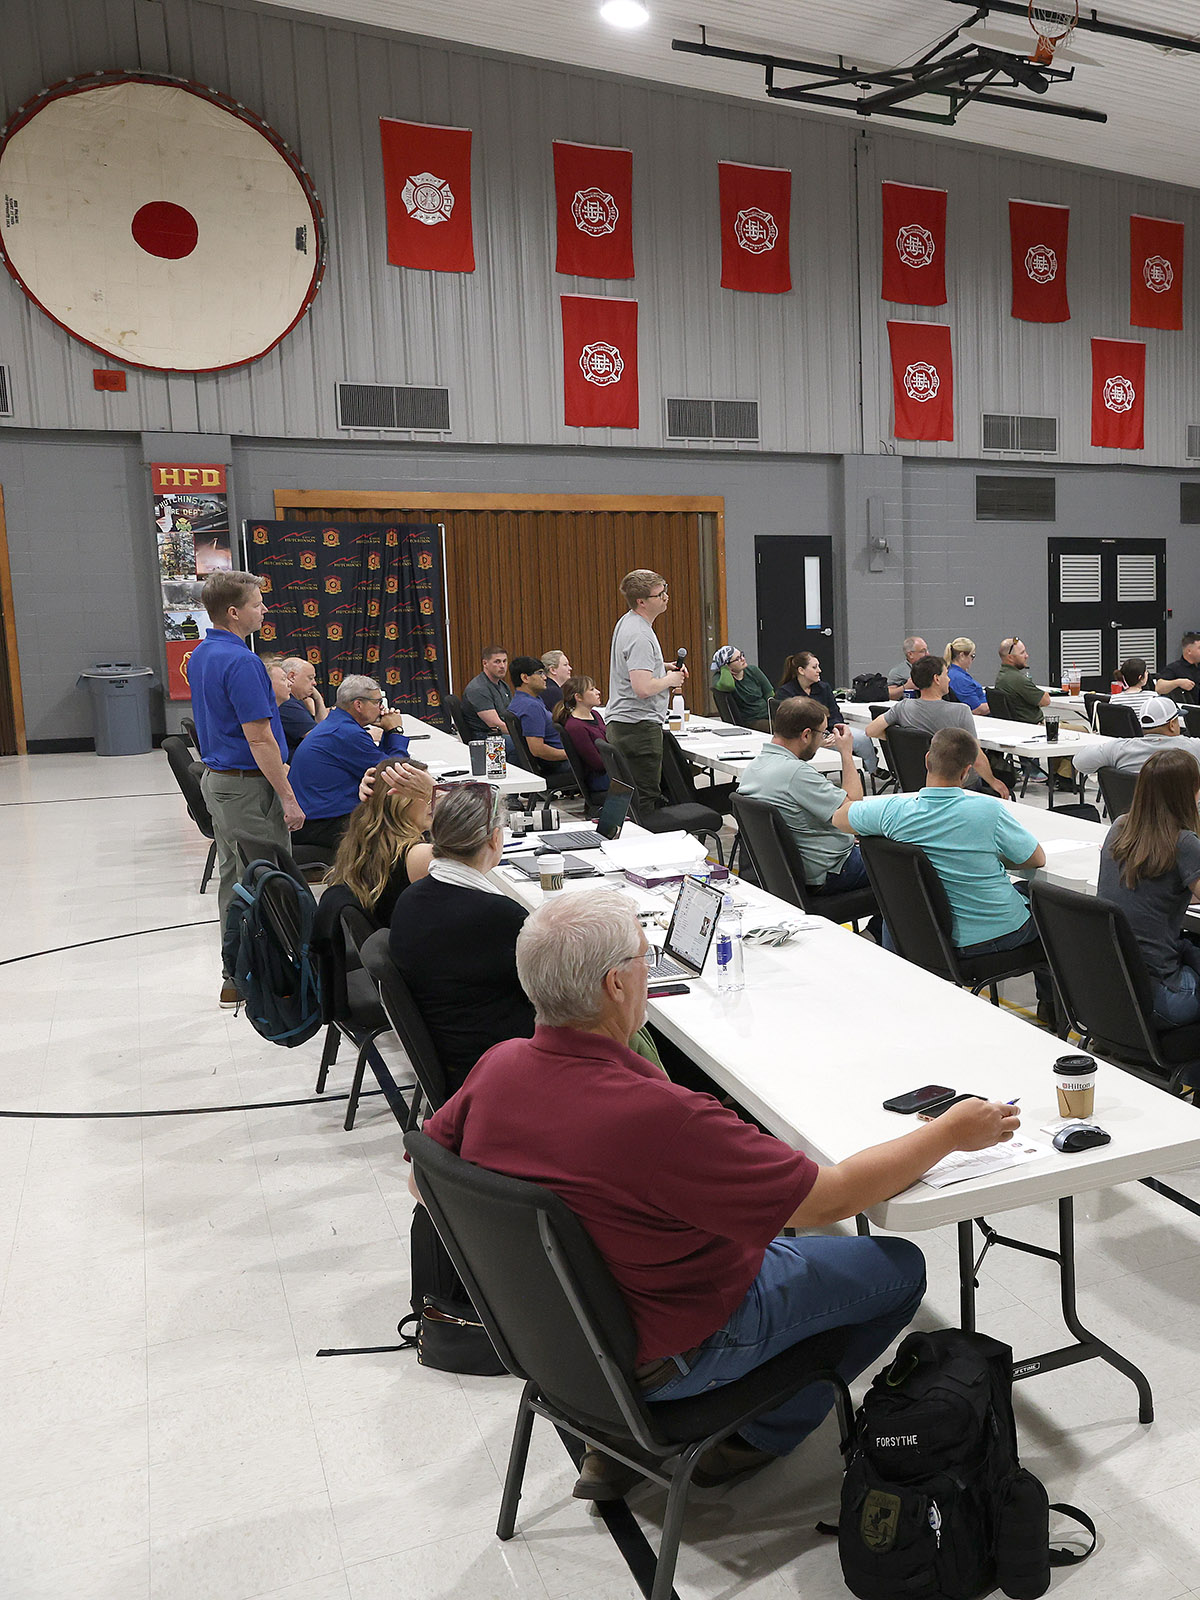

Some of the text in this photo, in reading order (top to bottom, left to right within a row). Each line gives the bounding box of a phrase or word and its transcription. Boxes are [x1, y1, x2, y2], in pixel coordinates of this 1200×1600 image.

[443, 190, 452, 212] HFD
[158, 467, 221, 487] HFD
[1067, 1082, 1091, 1090] Hilton
[1014, 1364, 1037, 1375] IFETIME
[876, 1434, 918, 1448] FORSYTHE
